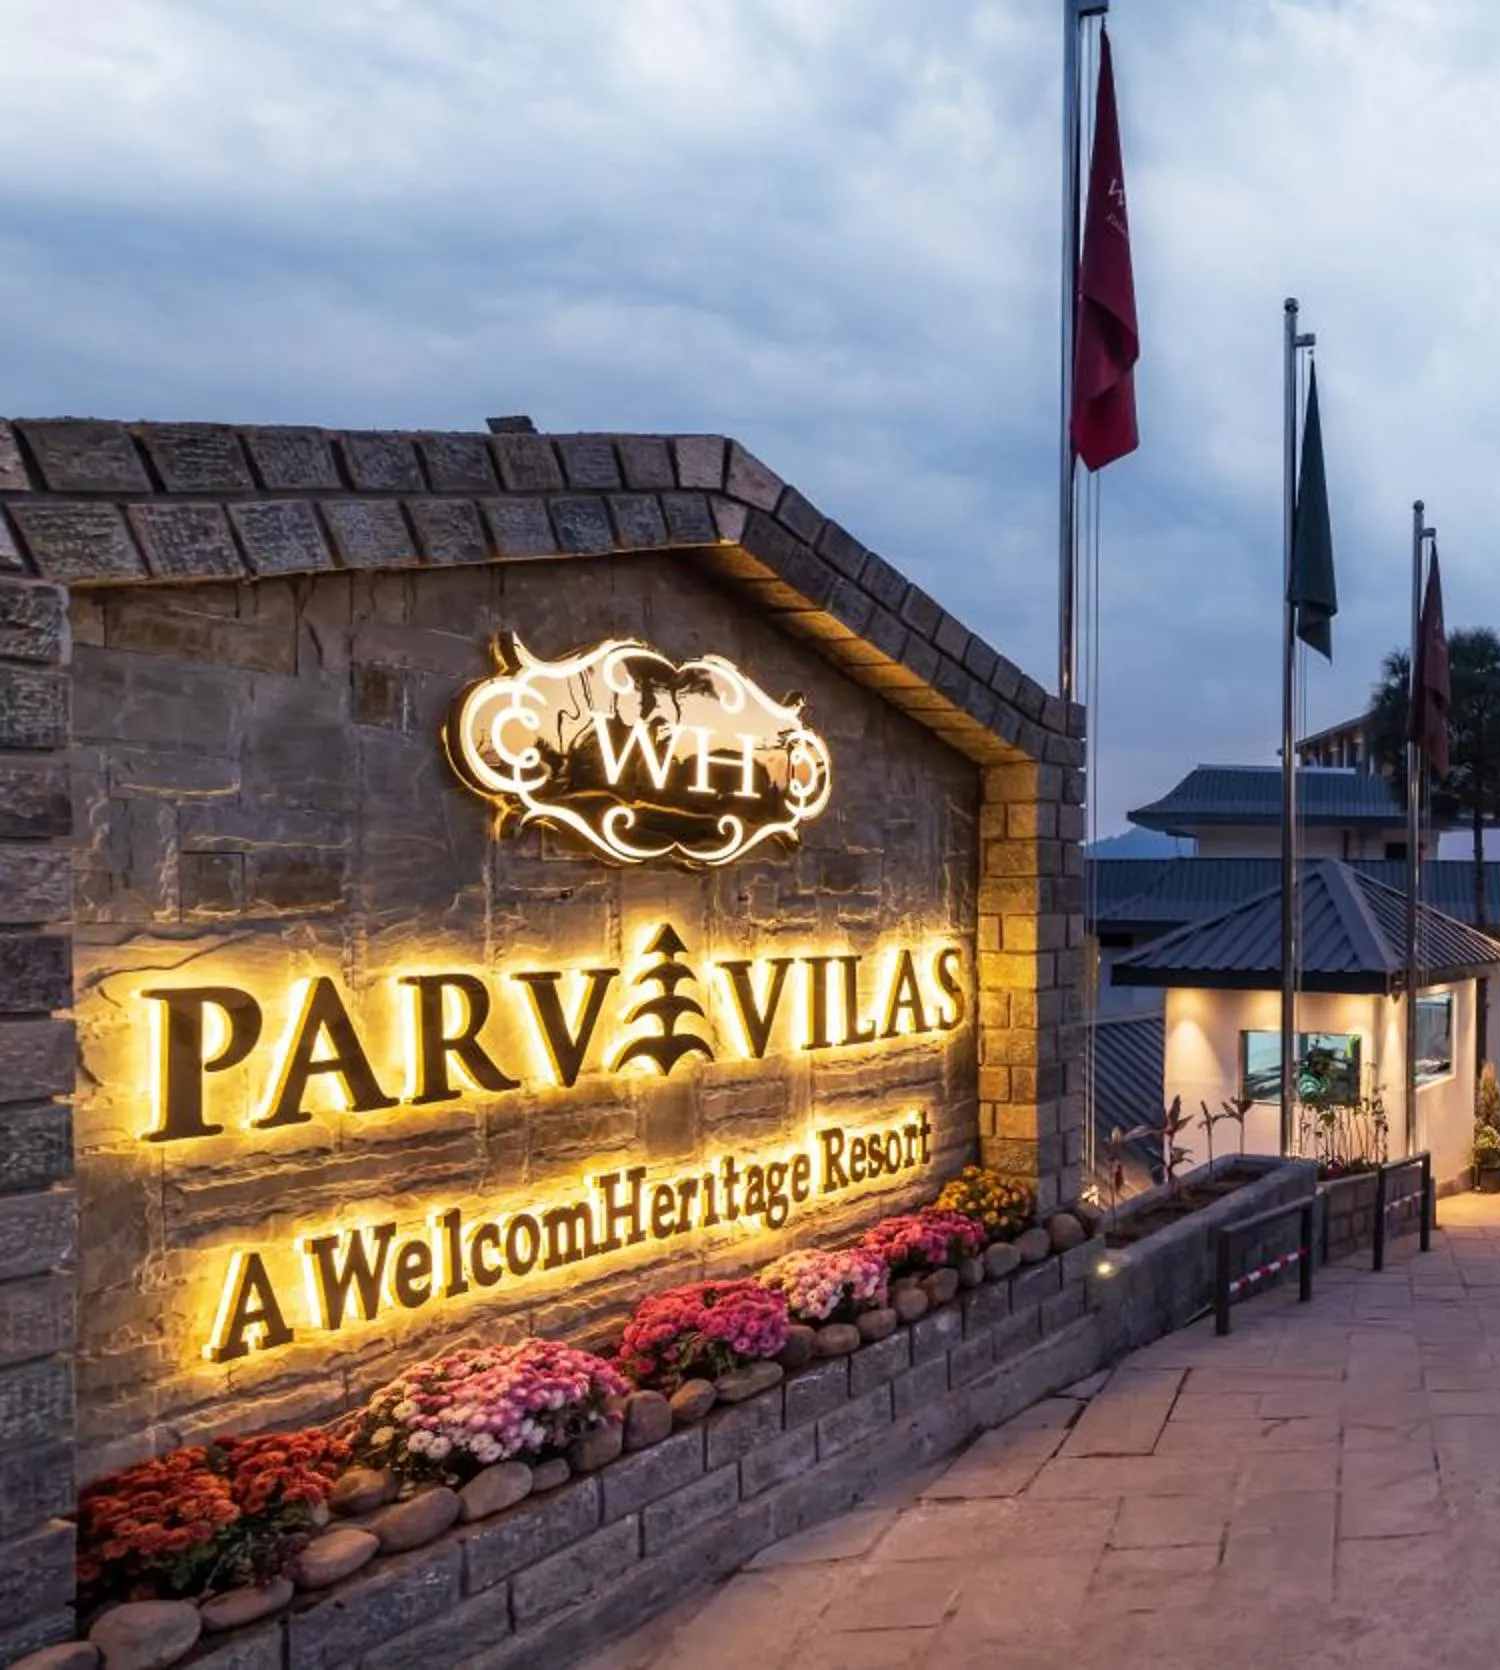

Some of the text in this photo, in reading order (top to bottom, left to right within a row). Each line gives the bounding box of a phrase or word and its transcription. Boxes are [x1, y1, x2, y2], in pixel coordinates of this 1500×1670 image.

[590, 710, 761, 799] WH
[139, 947, 966, 1142] PARV VILAS
[204, 1109, 932, 1362] A WelcomHeritage Resort
